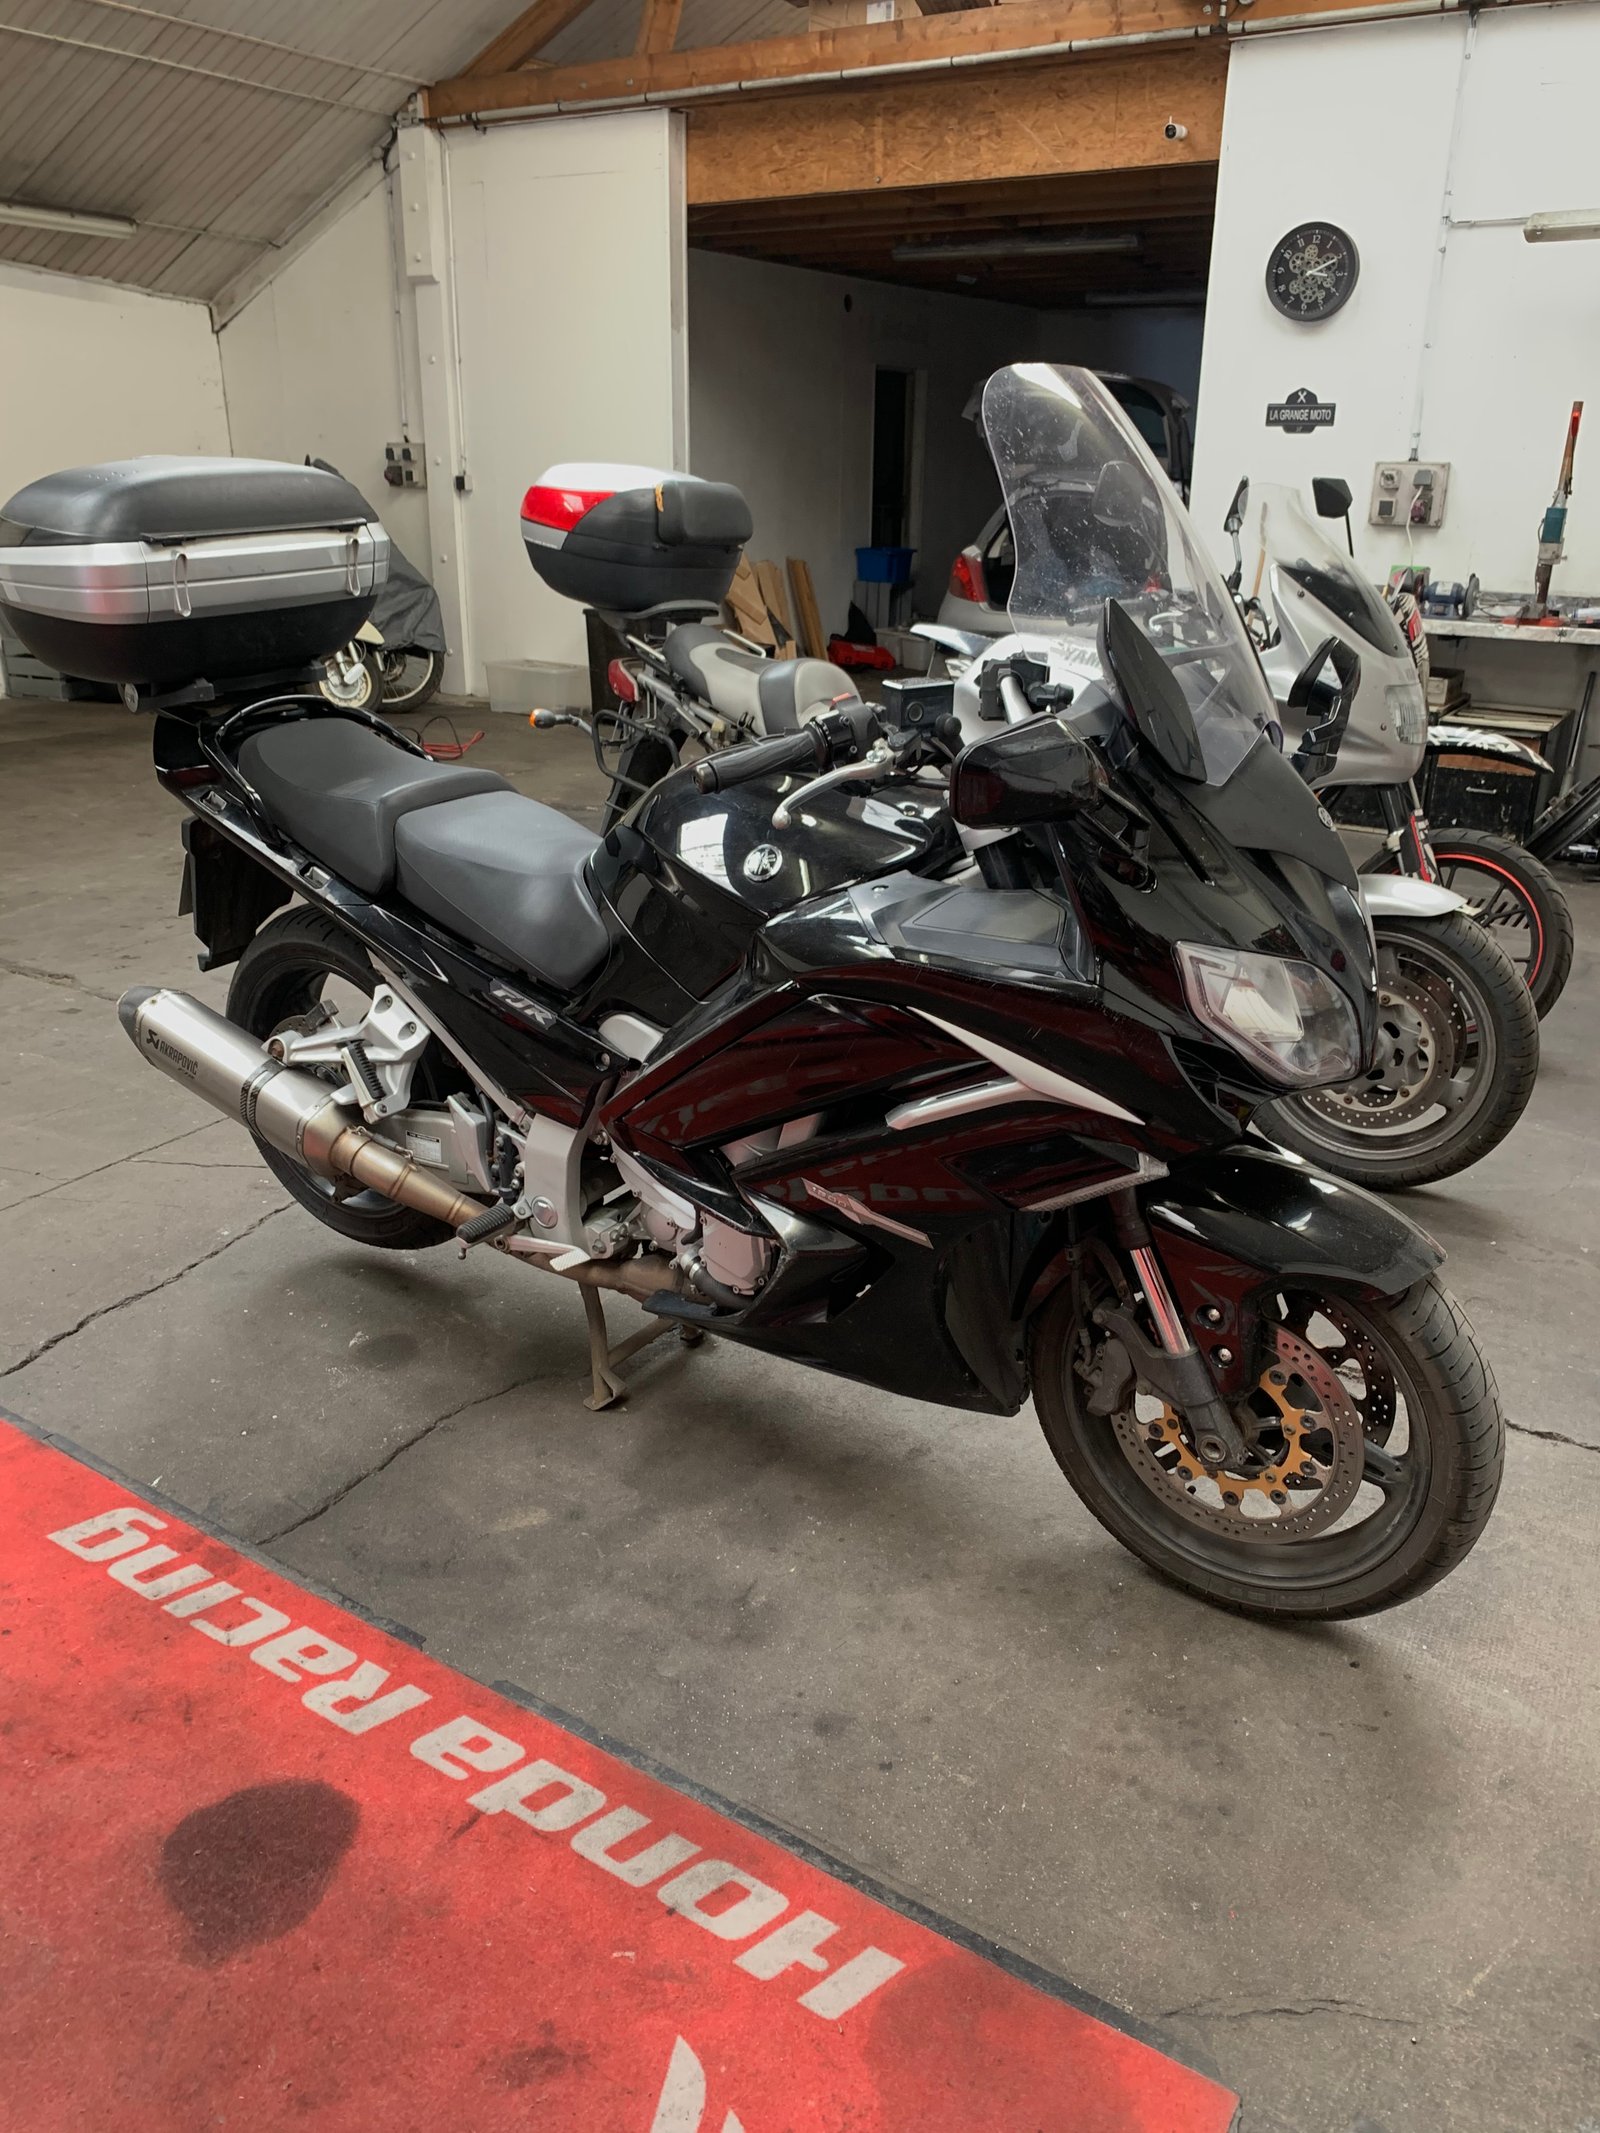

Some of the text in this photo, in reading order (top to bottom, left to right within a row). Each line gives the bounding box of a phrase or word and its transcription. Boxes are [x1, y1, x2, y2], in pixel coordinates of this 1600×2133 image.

[1297, 238, 1305, 248] 11
[1312, 235, 1321, 244] 12
[1326, 241, 1333, 249] 1
[1283, 249, 1293, 260] 10
[1278, 284, 1286, 293] 8
[1269, 409, 1332, 421] LA GRANGE MOTO
[492, 984, 553, 1026] FJR
[45, 1507, 908, 2021] Honda Racing
